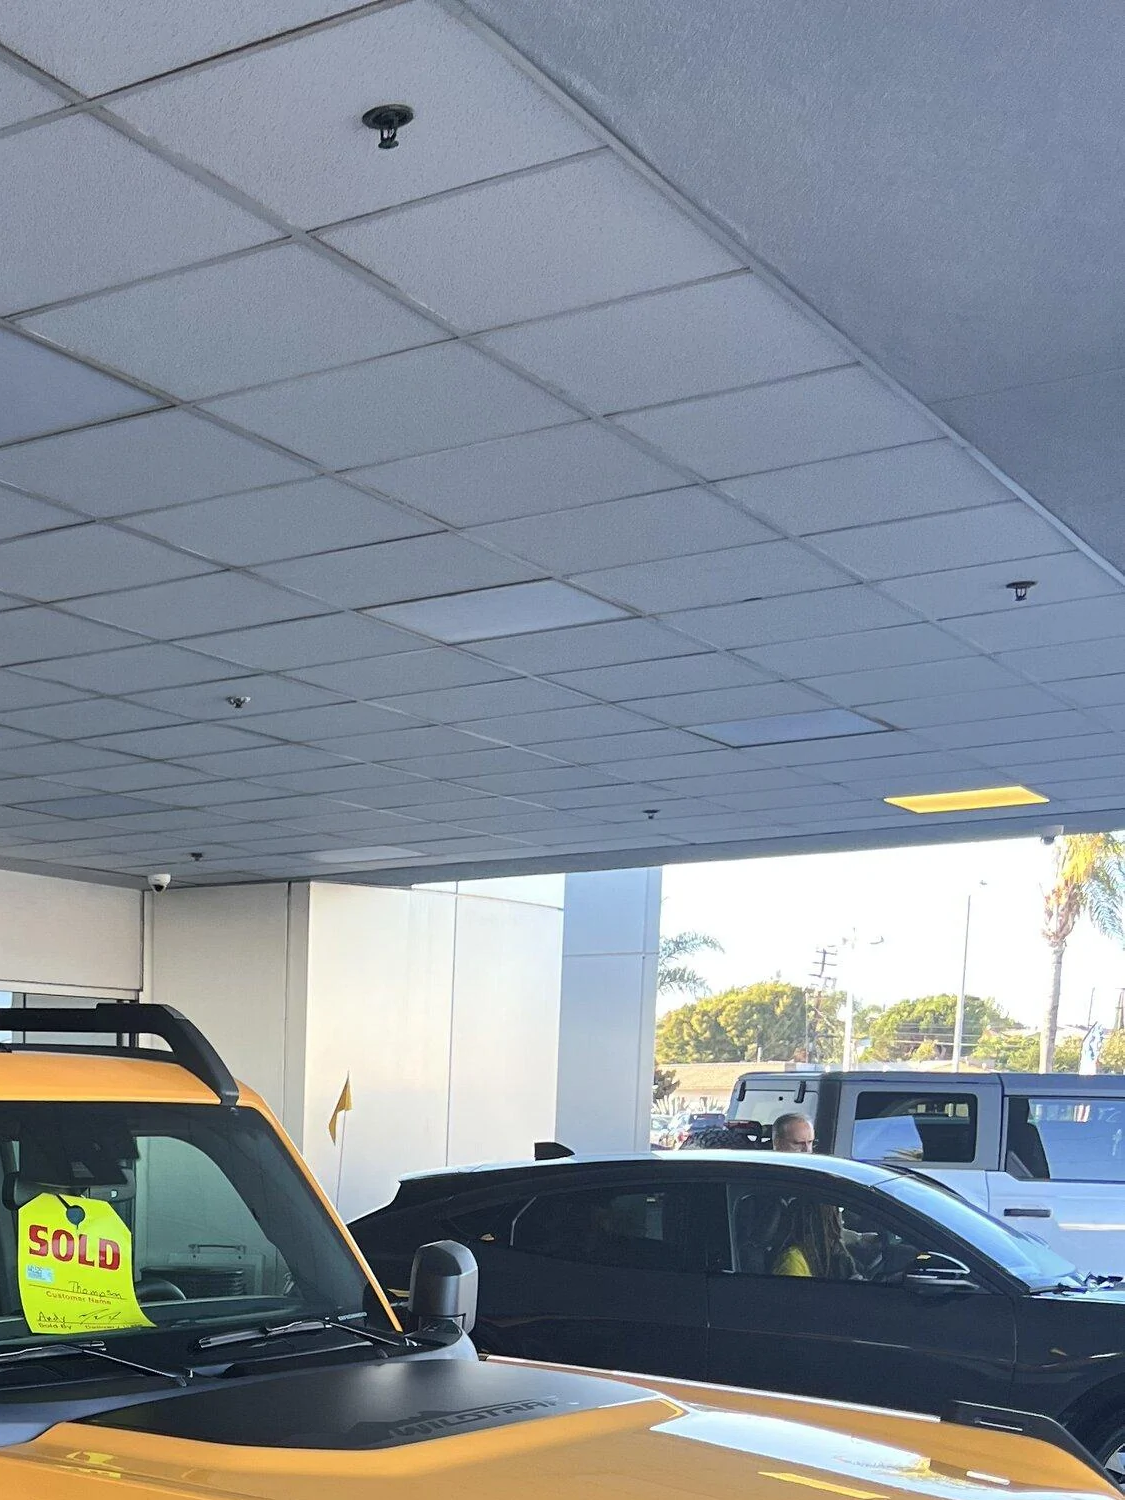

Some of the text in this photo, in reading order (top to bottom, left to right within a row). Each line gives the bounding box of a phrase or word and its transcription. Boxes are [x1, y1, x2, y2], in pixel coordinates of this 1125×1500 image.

[29, 1224, 121, 1271] SOLD
[46, 1290, 112, 1305] Customer Name
